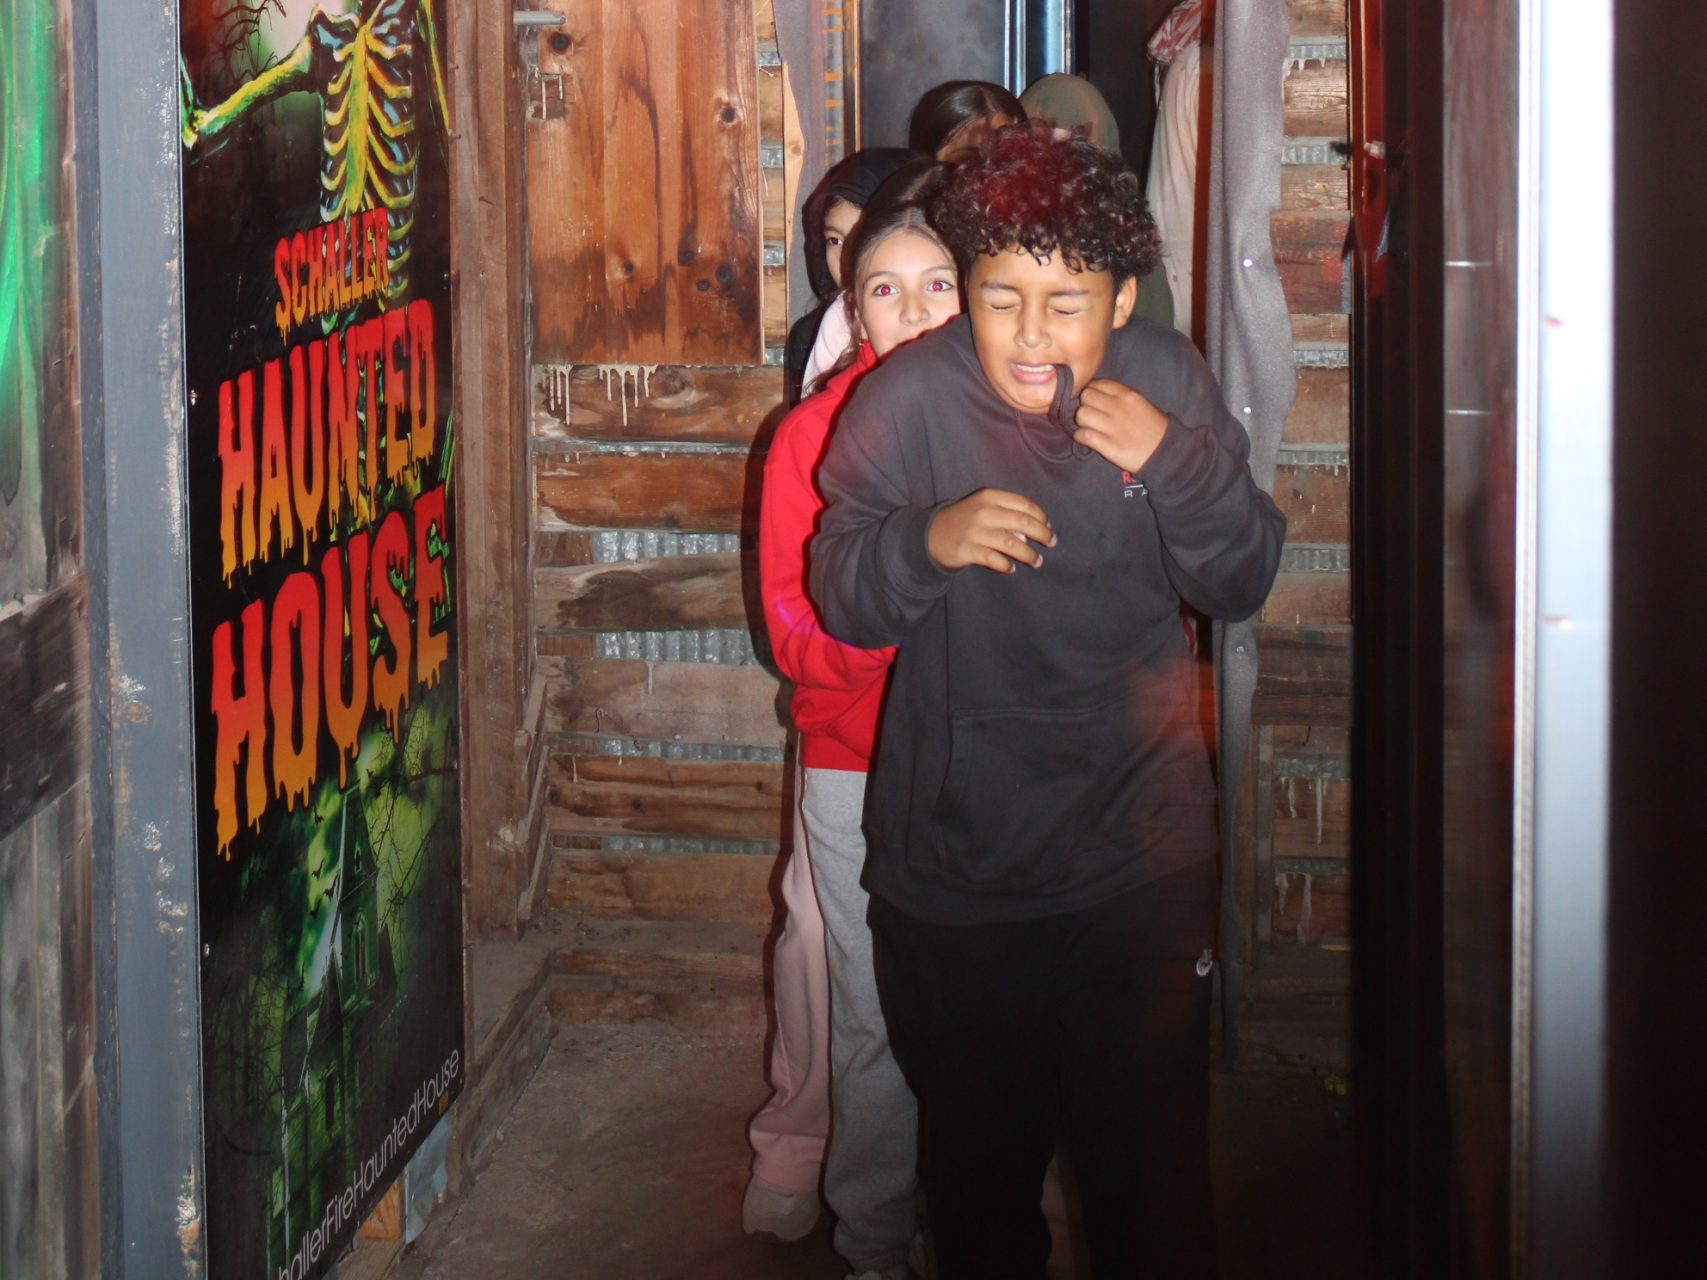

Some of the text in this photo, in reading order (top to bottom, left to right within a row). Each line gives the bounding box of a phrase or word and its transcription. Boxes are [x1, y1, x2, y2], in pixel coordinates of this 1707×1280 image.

[274, 207, 391, 346] SCHALLER
[217, 298, 439, 590] HAUNTED
[211, 481, 450, 862] HOUSE
